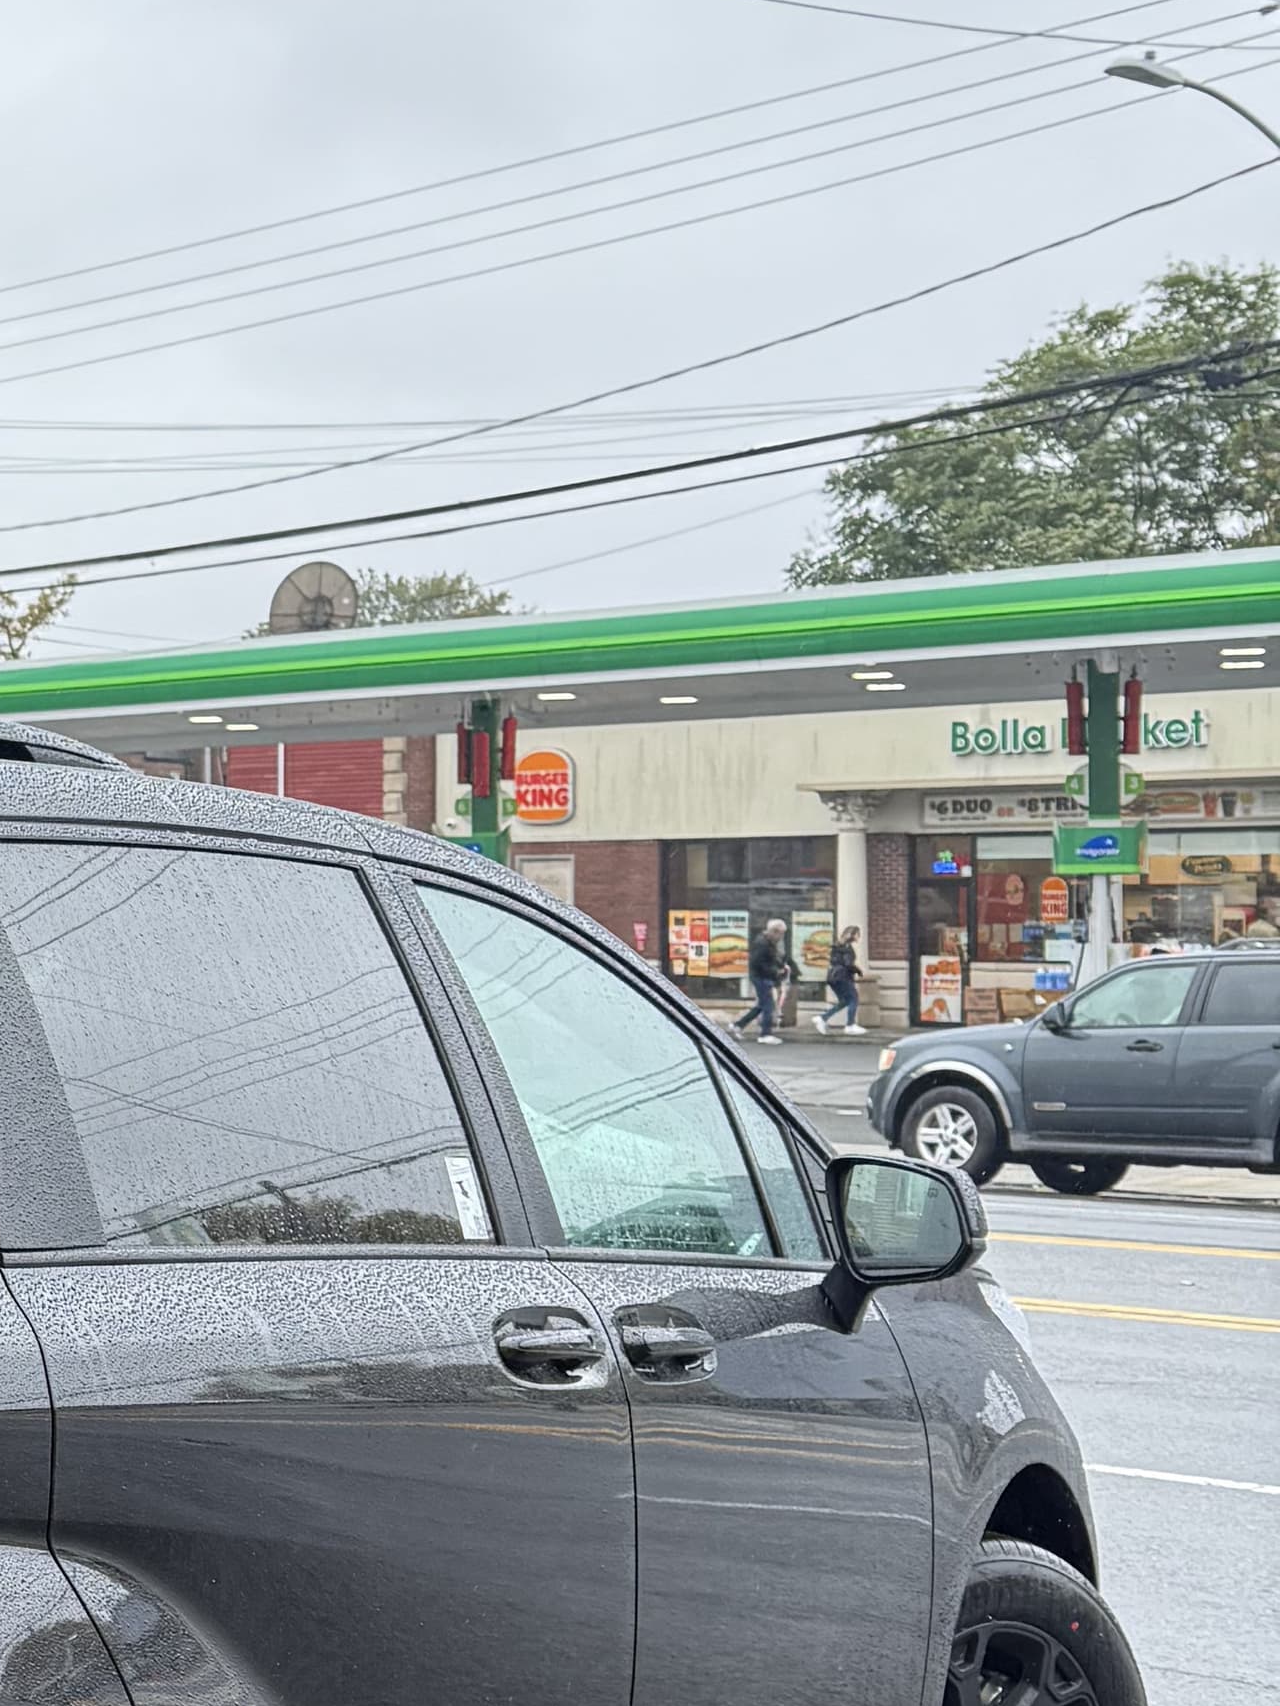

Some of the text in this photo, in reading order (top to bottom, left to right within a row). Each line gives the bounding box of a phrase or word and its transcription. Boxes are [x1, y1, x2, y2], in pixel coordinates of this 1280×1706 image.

[951, 718, 1047, 754] Bolla
[515, 772, 569, 786] BURGER
[1069, 777, 1081, 791] 4
[1129, 776, 1140, 790] 3
[515, 788, 569, 808] KING
[951, 798, 993, 814] DUO
